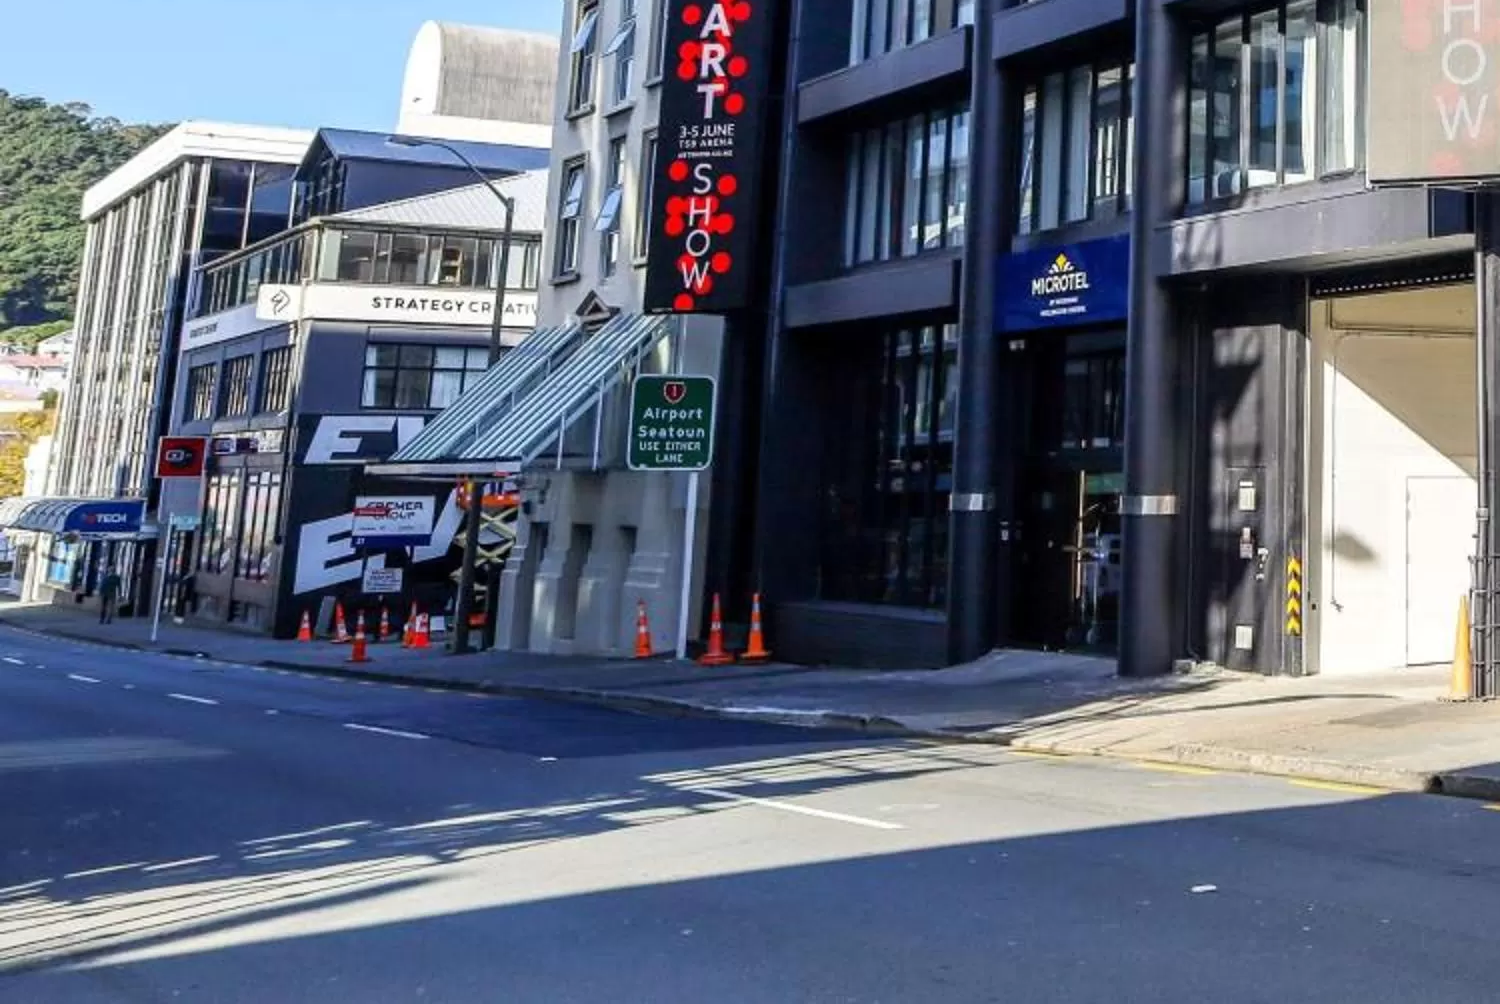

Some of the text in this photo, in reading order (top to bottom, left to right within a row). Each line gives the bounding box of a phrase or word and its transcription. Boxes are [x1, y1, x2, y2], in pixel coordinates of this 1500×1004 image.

[696, 3, 732, 120] ART
[679, 123, 736, 139] 3-5 JUNE
[700, 137, 734, 147] ARENA
[681, 163, 713, 289] SHOW
[1031, 271, 1090, 296] MICROTEL
[372, 297, 538, 316] STRATEGY CRATI
[643, 407, 704, 422] Airport
[638, 425, 706, 439] Seatoun
[639, 441, 701, 451] USE EITHER
[655, 453, 684, 464] LANE
